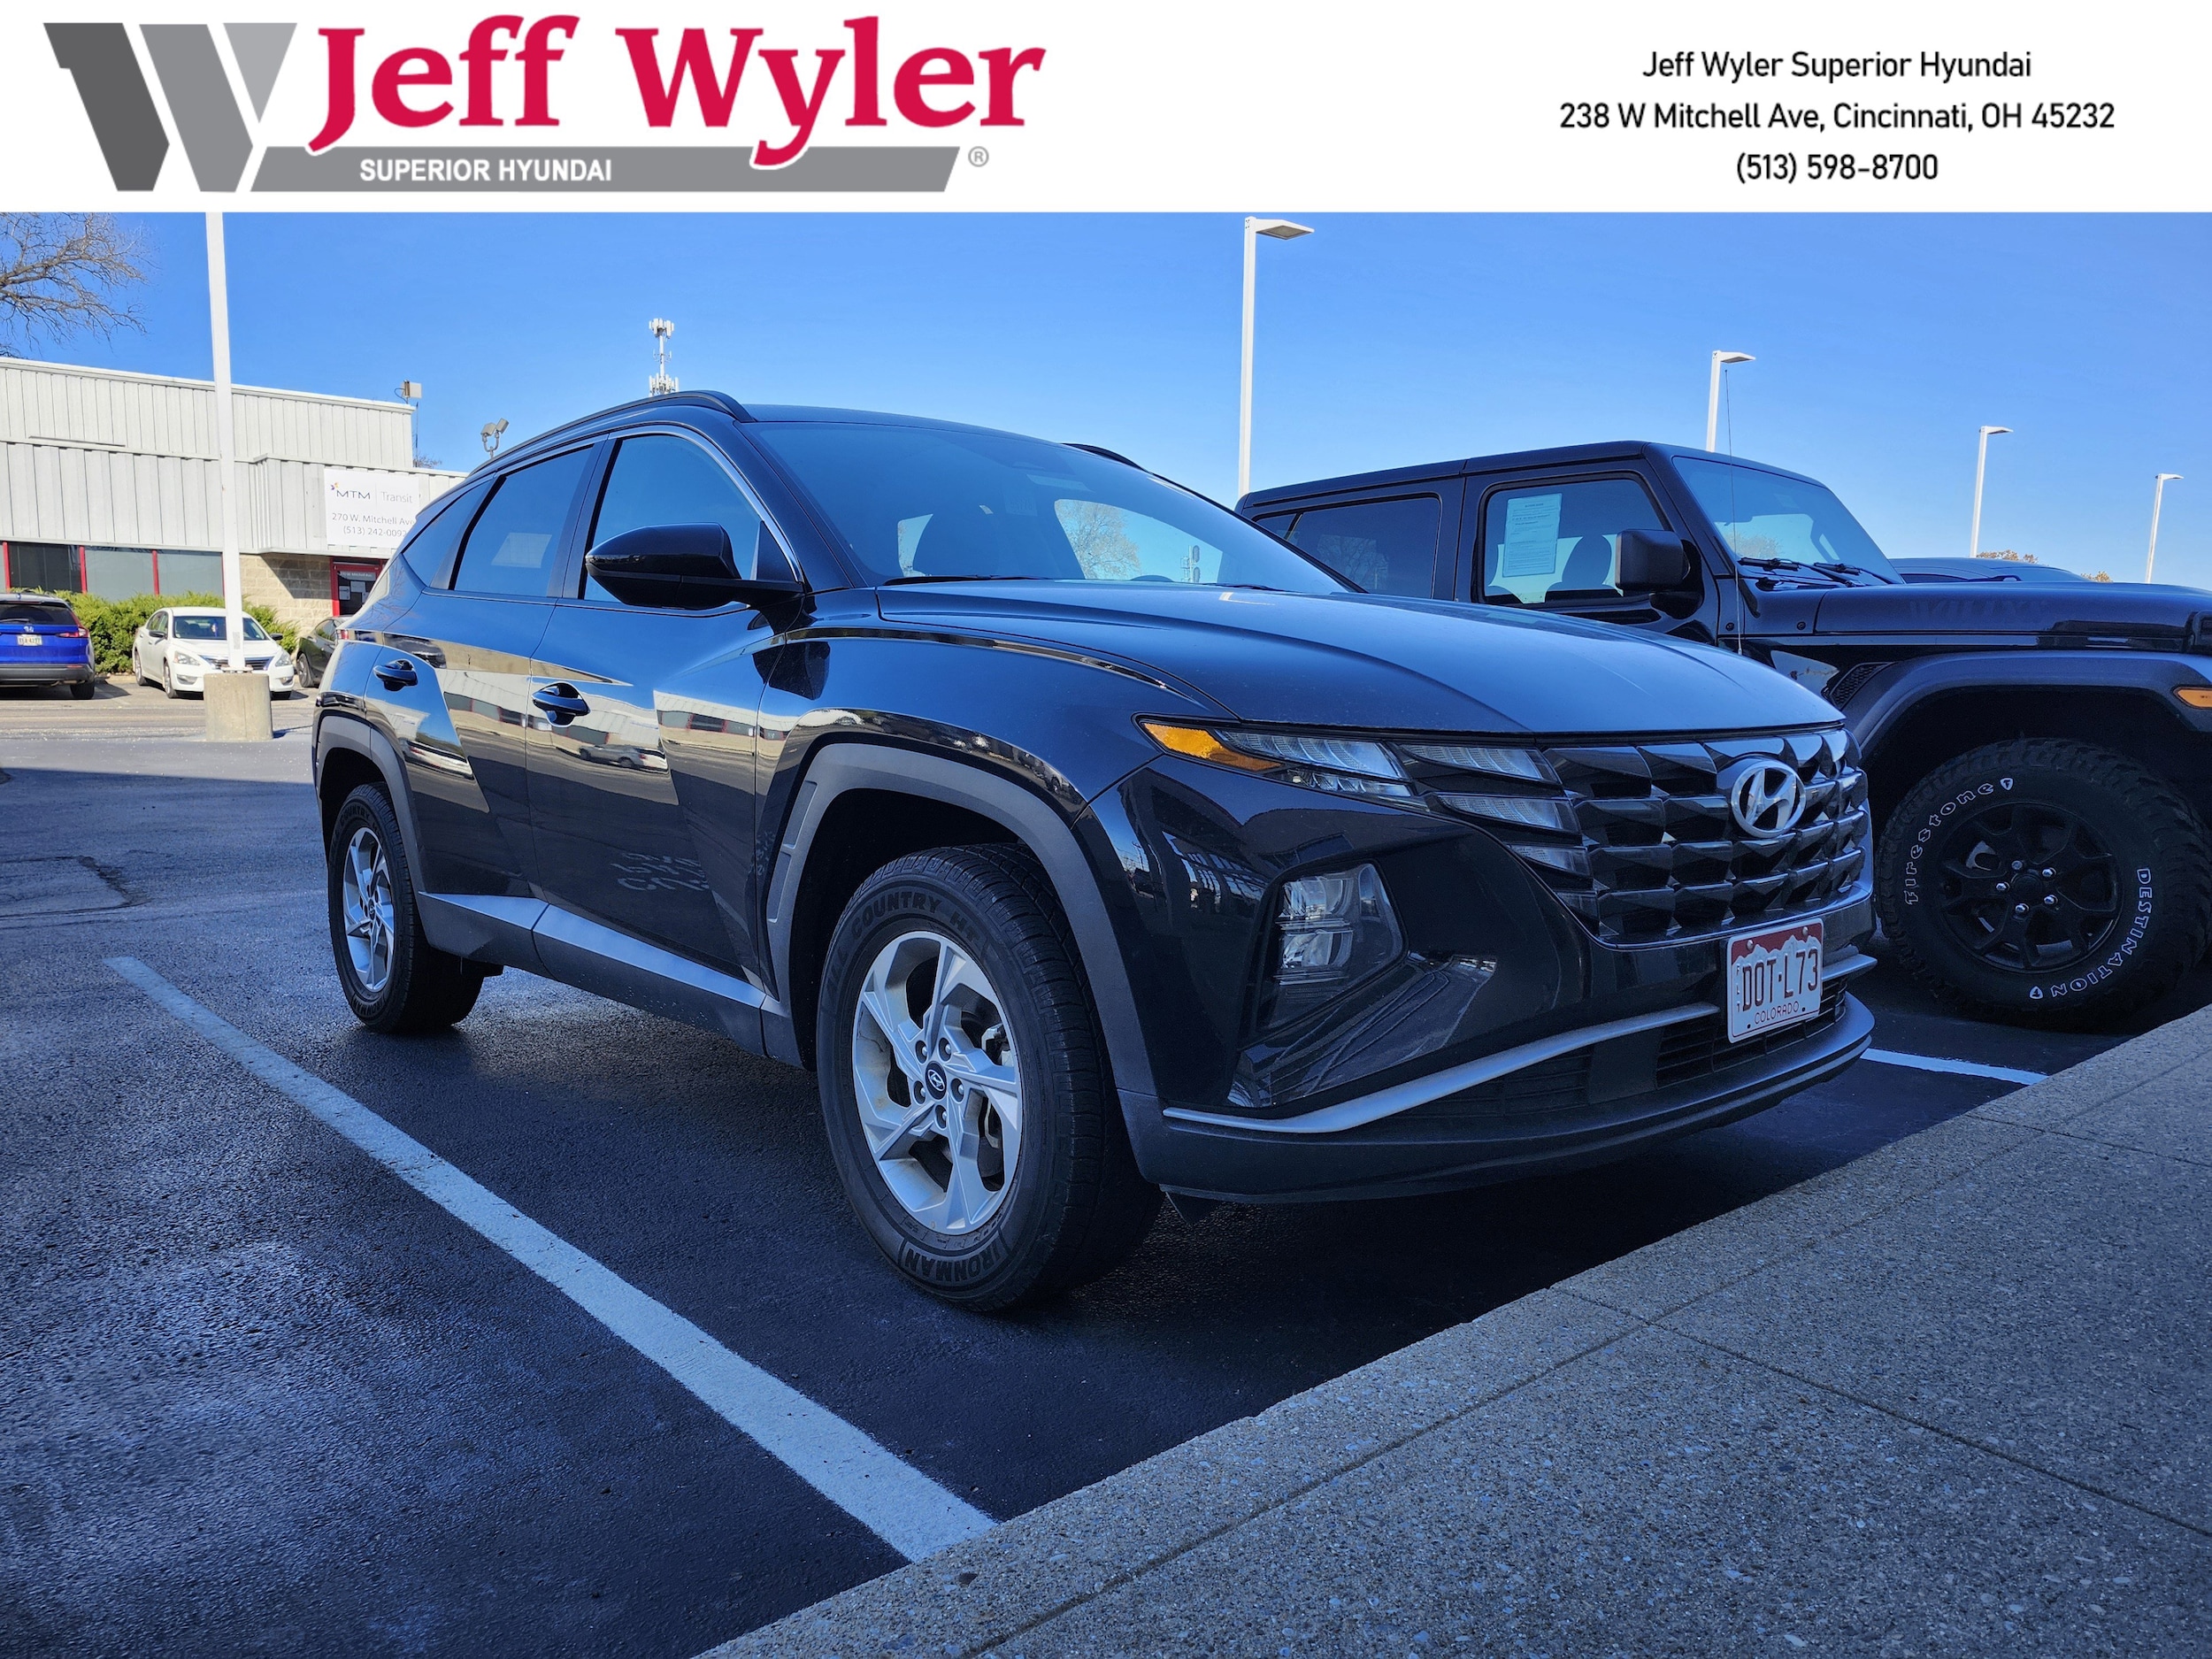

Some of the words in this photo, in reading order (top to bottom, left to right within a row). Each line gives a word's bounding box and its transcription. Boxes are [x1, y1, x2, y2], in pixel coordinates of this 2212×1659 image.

[336, 489, 371, 500] MTM
[381, 491, 413, 503] Transit
[332, 512, 349, 521] 270
[363, 515, 397, 525] Mitchell
[343, 526, 365, 535] (513)
[1903, 783, 1994, 905] Firestone
[851, 891, 943, 940] COUNTRY
[2048, 868, 2153, 998] DESTINATION
[1754, 1001, 1800, 1025] COLORADO
[904, 1243, 1002, 1283] IRONMAN
